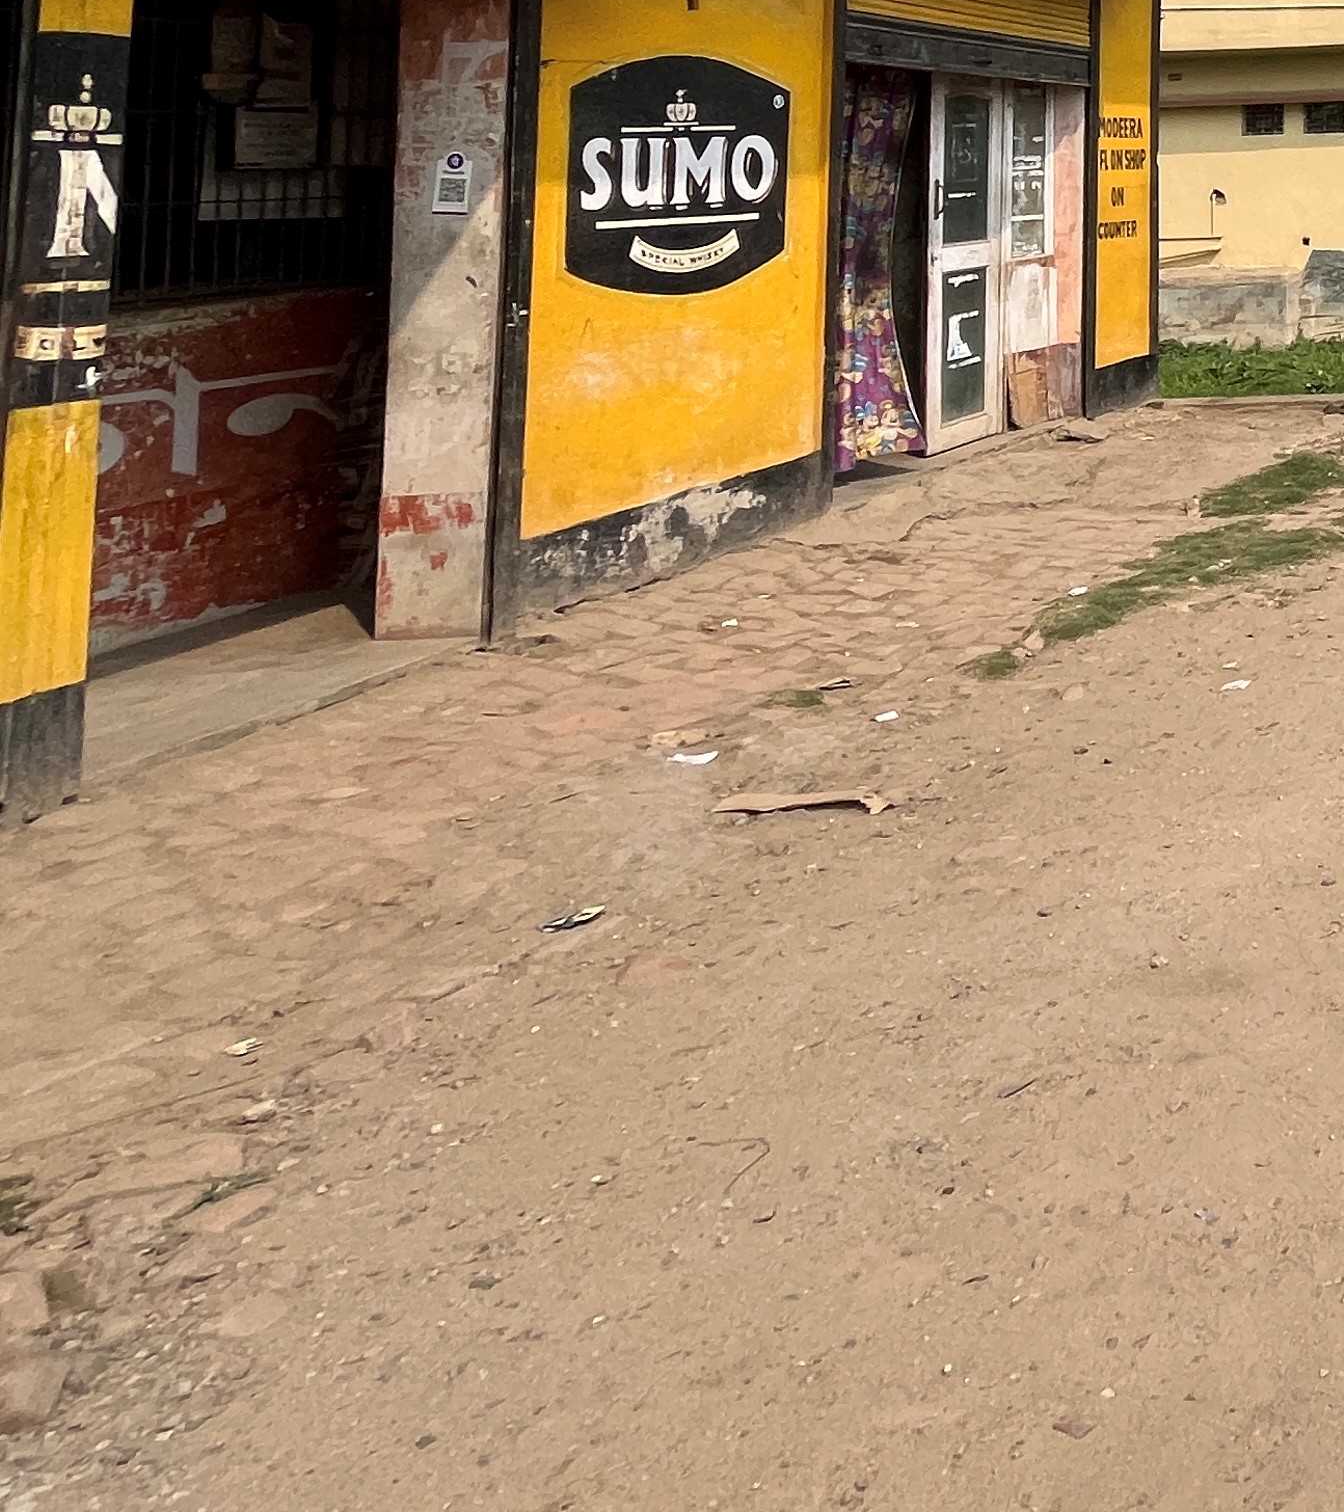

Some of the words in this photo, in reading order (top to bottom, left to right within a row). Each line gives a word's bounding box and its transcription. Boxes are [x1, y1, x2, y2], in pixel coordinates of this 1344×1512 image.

[1099, 117, 1144, 139] MODEERA
[1100, 149, 1109, 171] FL
[1110, 149, 1124, 171] ON
[1124, 148, 1147, 171] SHOP
[580, 134, 779, 211] SUMO
[1110, 186, 1125, 207] ON
[1098, 220, 1138, 240] COUNTER
[641, 249, 685, 266] SPECIAL
[689, 247, 724, 263] WHISKY
